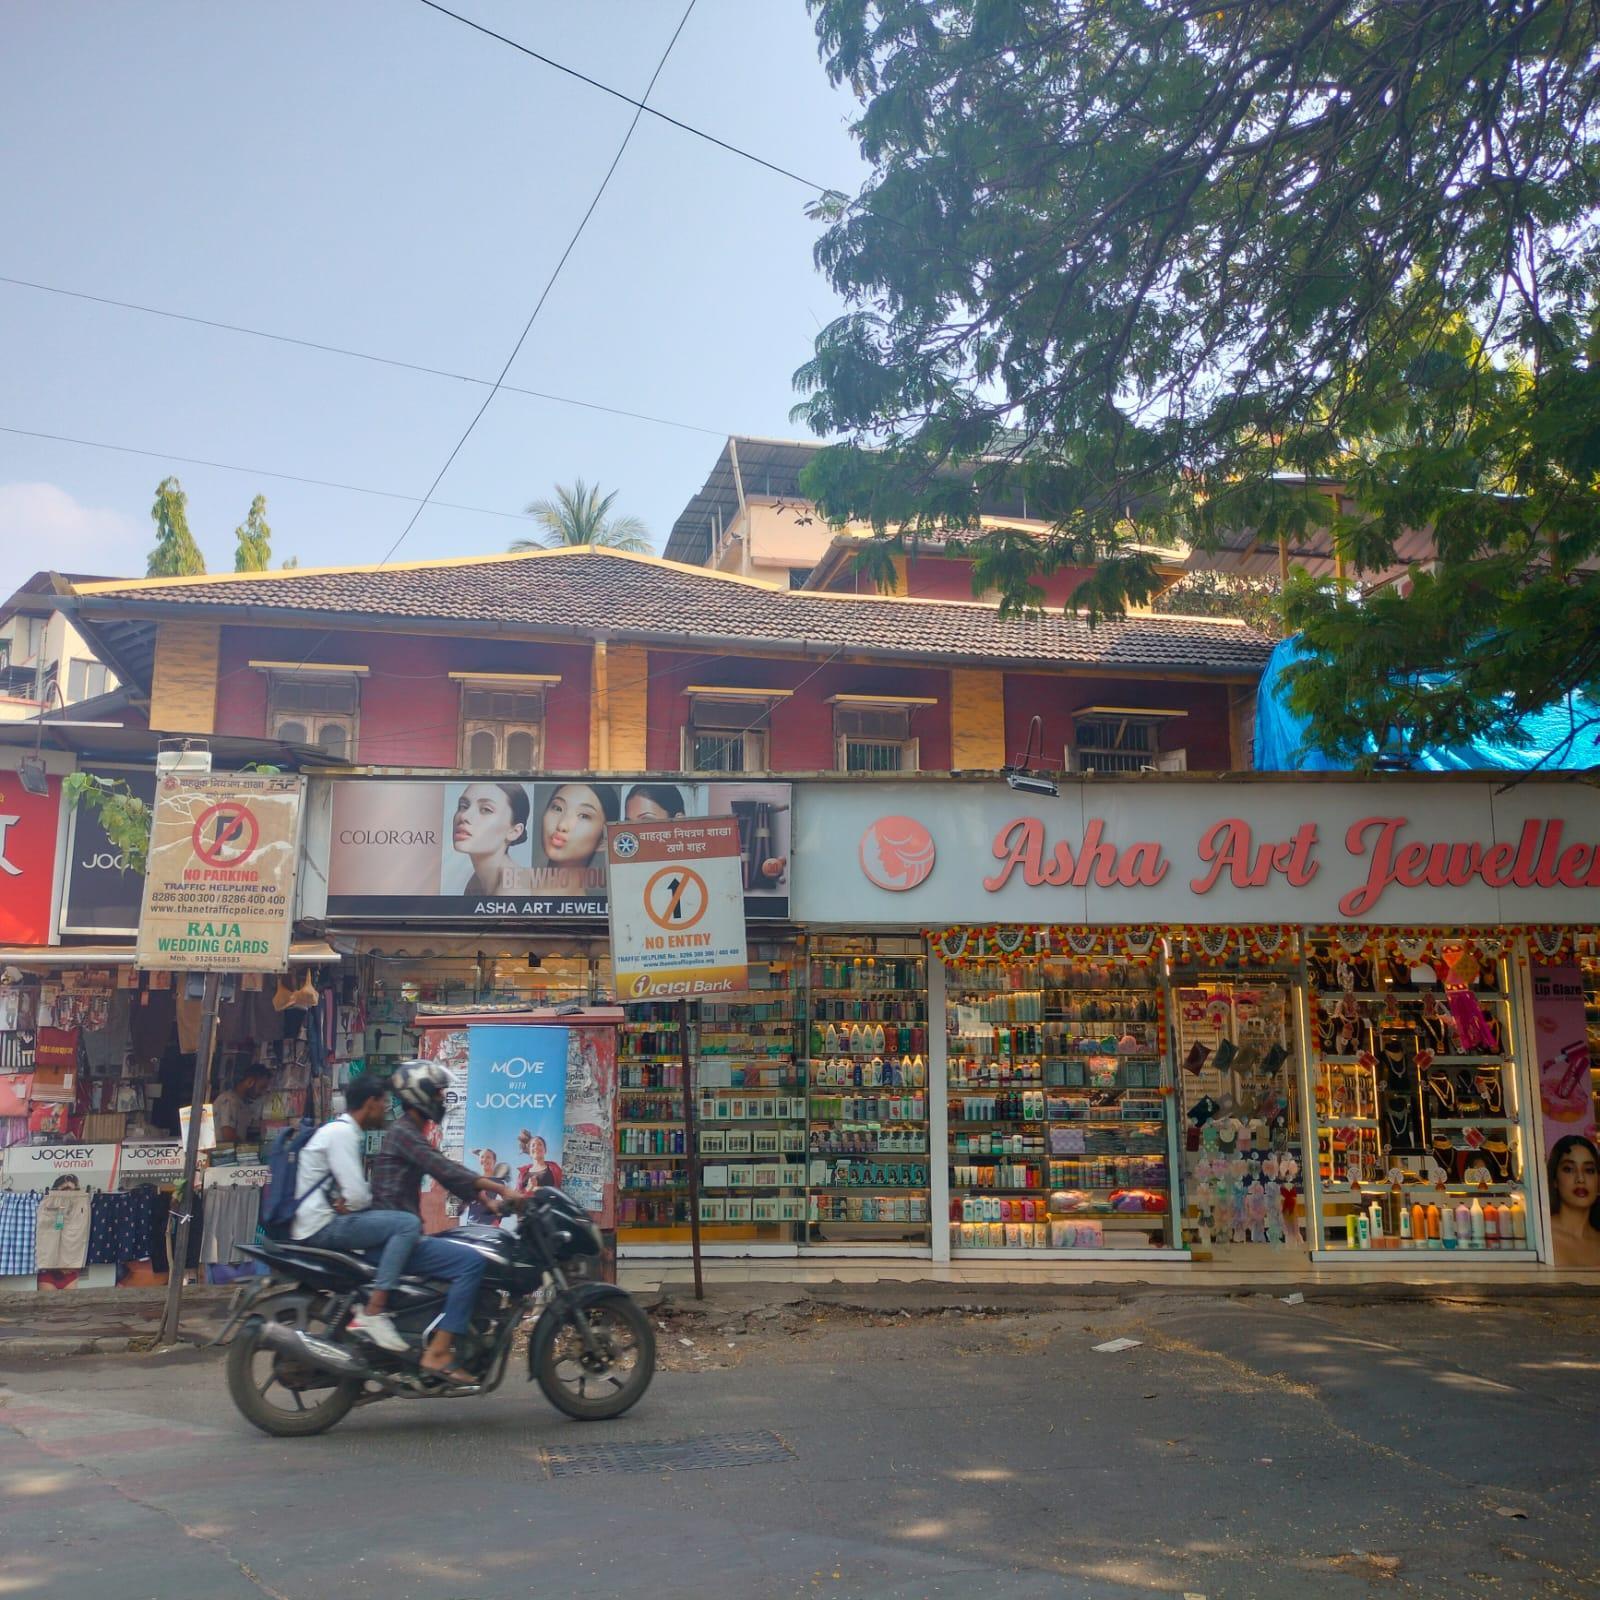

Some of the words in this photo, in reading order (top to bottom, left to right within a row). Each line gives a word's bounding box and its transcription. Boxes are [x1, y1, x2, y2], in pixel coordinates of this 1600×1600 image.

[640, 830, 672, 843] वाहतूक
[707, 827, 732, 837] शाखा
[686, 842, 706, 853] शहर
[82, 853, 134, 869] JOC
[983, 816, 1170, 893] Asha
[1190, 817, 1320, 895] Art
[184, 869, 200, 882] NO
[203, 869, 258, 882] PARKING
[502, 868, 524, 890] BE
[530, 867, 569, 889] WHO
[578, 867, 607, 889] YOU
[164, 882, 206, 891] TRAFFIC
[209, 884, 258, 893] HELPLINE
[261, 885, 276, 893] NO
[152, 893, 176, 902] 8286
[178, 893, 196, 902] 300
[197, 894, 215, 902] 300
[222, 894, 246, 903] 8286
[248, 895, 266, 904] 400
[267, 896, 285, 904] 400
[150, 904, 284, 917] www.thanetrafficpolice.org
[474, 902, 517, 914] ASHA
[521, 902, 553, 914] ART
[187, 922, 241, 938] RAJA
[158, 938, 219, 953] WEDDING
[224, 940, 269, 954] CARDS
[645, 935, 665, 950] NO
[668, 933, 711, 949] ENTRY
[618, 955, 640, 963] TRAFFIC
[649, 981, 690, 996] ICICI
[693, 978, 732, 993] Bank
[490, 1057, 545, 1078] MOVE
[508, 1081, 527, 1090] WITH
[476, 1093, 557, 1109] JOCKEY
[32, 1148, 94, 1160] JOCKEY
[128, 1148, 180, 1158] JOCKEY
[53, 1160, 94, 1168] woman
[146, 1158, 181, 1166] woman
